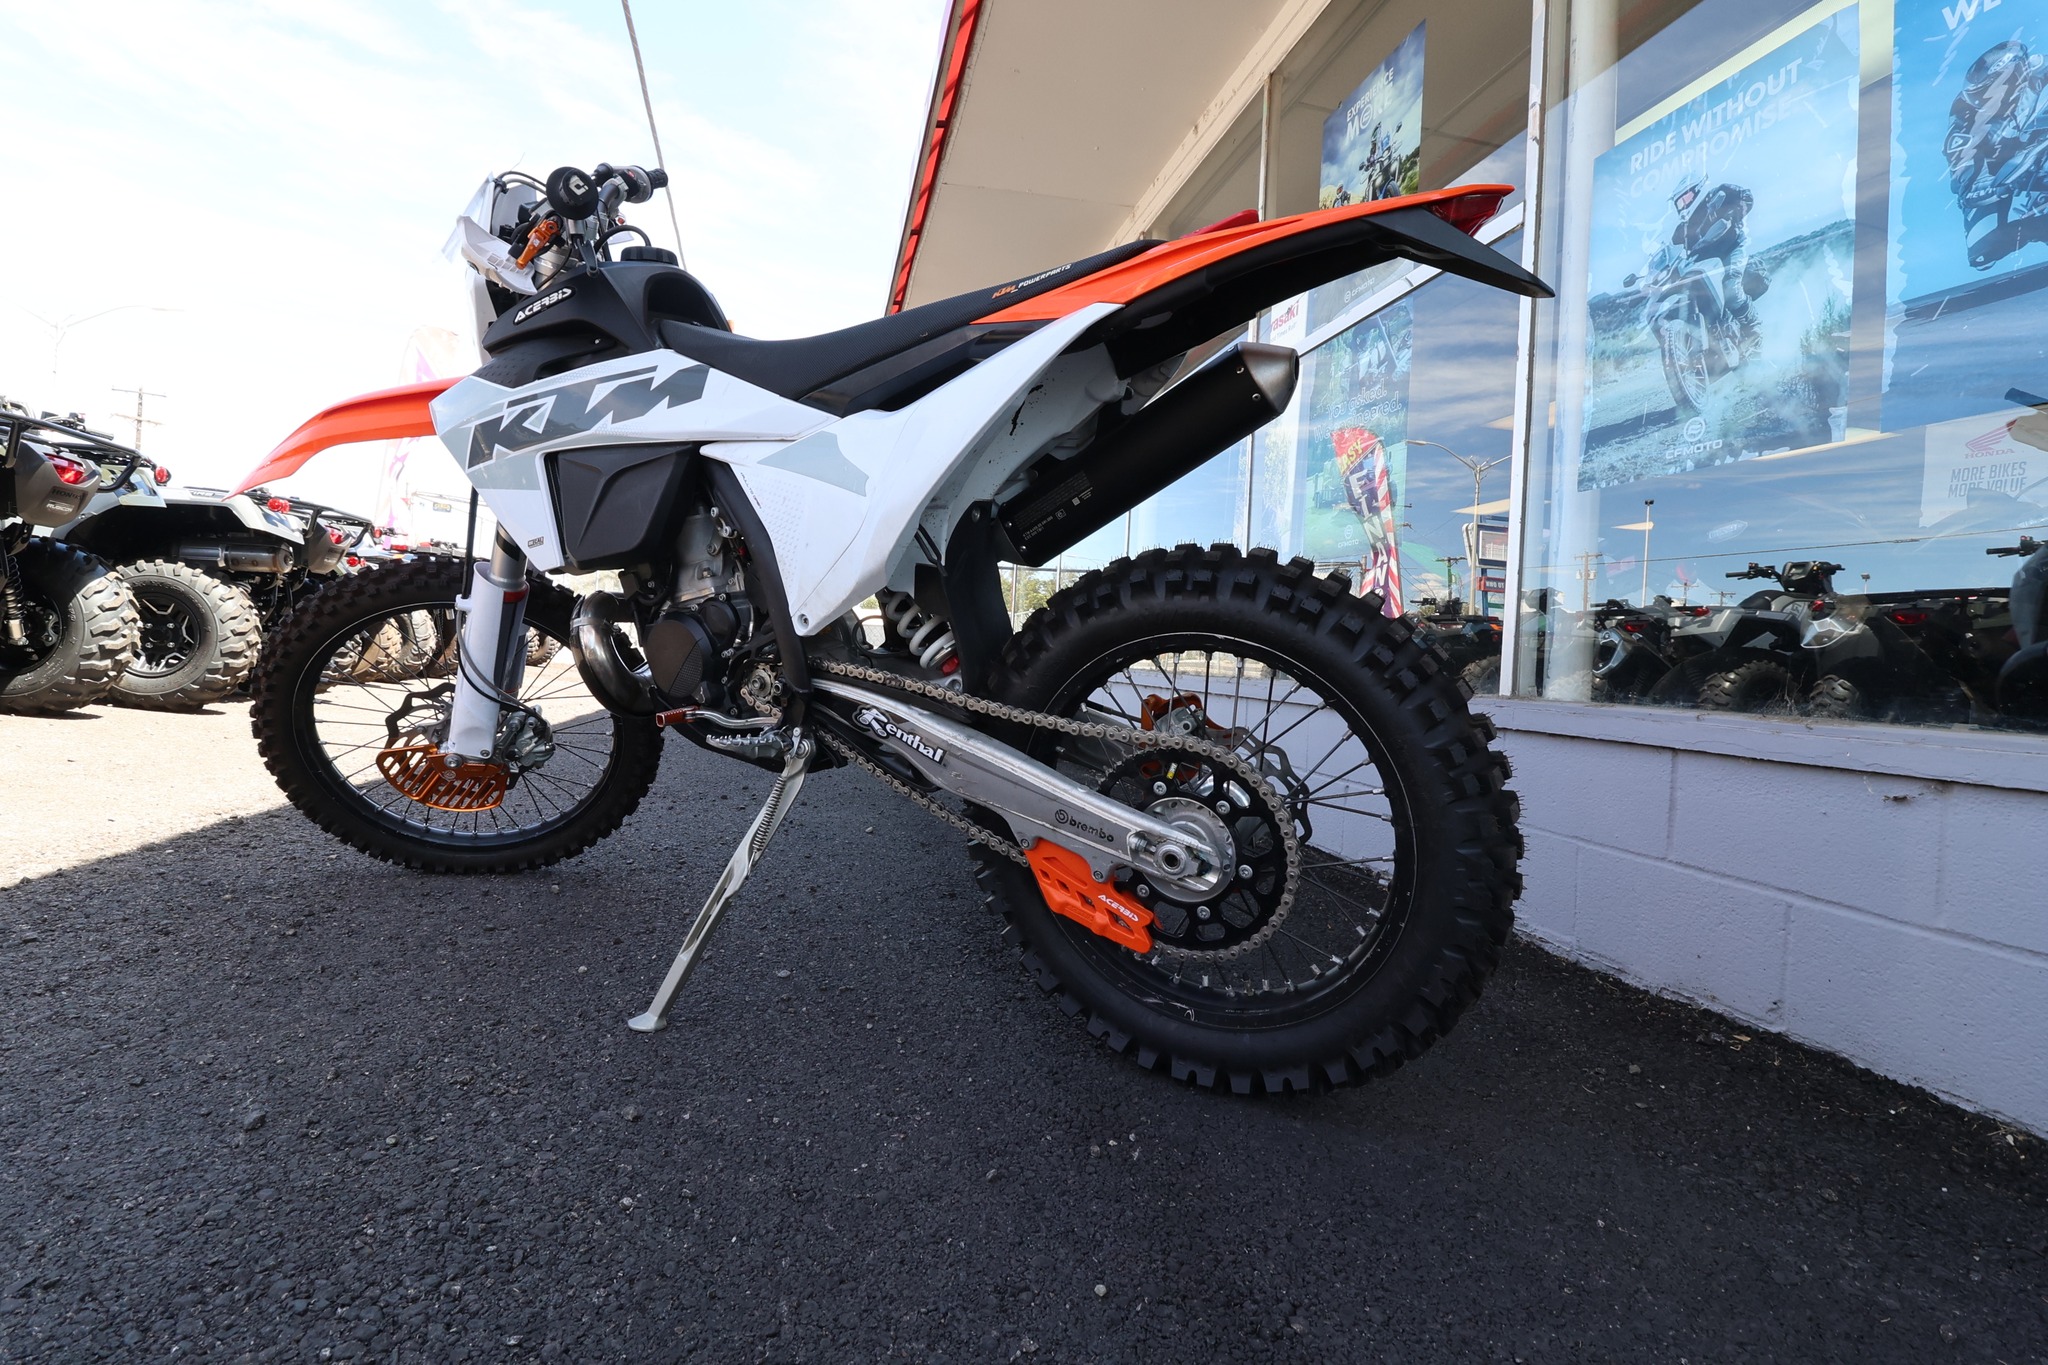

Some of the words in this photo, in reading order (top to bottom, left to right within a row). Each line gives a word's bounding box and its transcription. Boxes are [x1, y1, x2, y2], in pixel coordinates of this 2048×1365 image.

[1630, 130, 1677, 175] RIDE
[1681, 57, 1803, 145] WITHOUT
[1630, 94, 1793, 198] COMPROMISE
[1018, 263, 1072, 288] POWERPARTS
[513, 287, 573, 324] ACERBIS
[1271, 301, 1300, 331] asaki
[467, 362, 711, 471] KTM
[1666, 439, 1723, 460] CFMOTO
[1964, 447, 2016, 459] HONDA
[1950, 466, 1986, 483] MORE
[1988, 461, 2027, 480] BIKES
[852, 704, 944, 764] Renthal
[1068, 817, 1115, 844] brembo
[1097, 893, 1140, 923] ACERBIS
